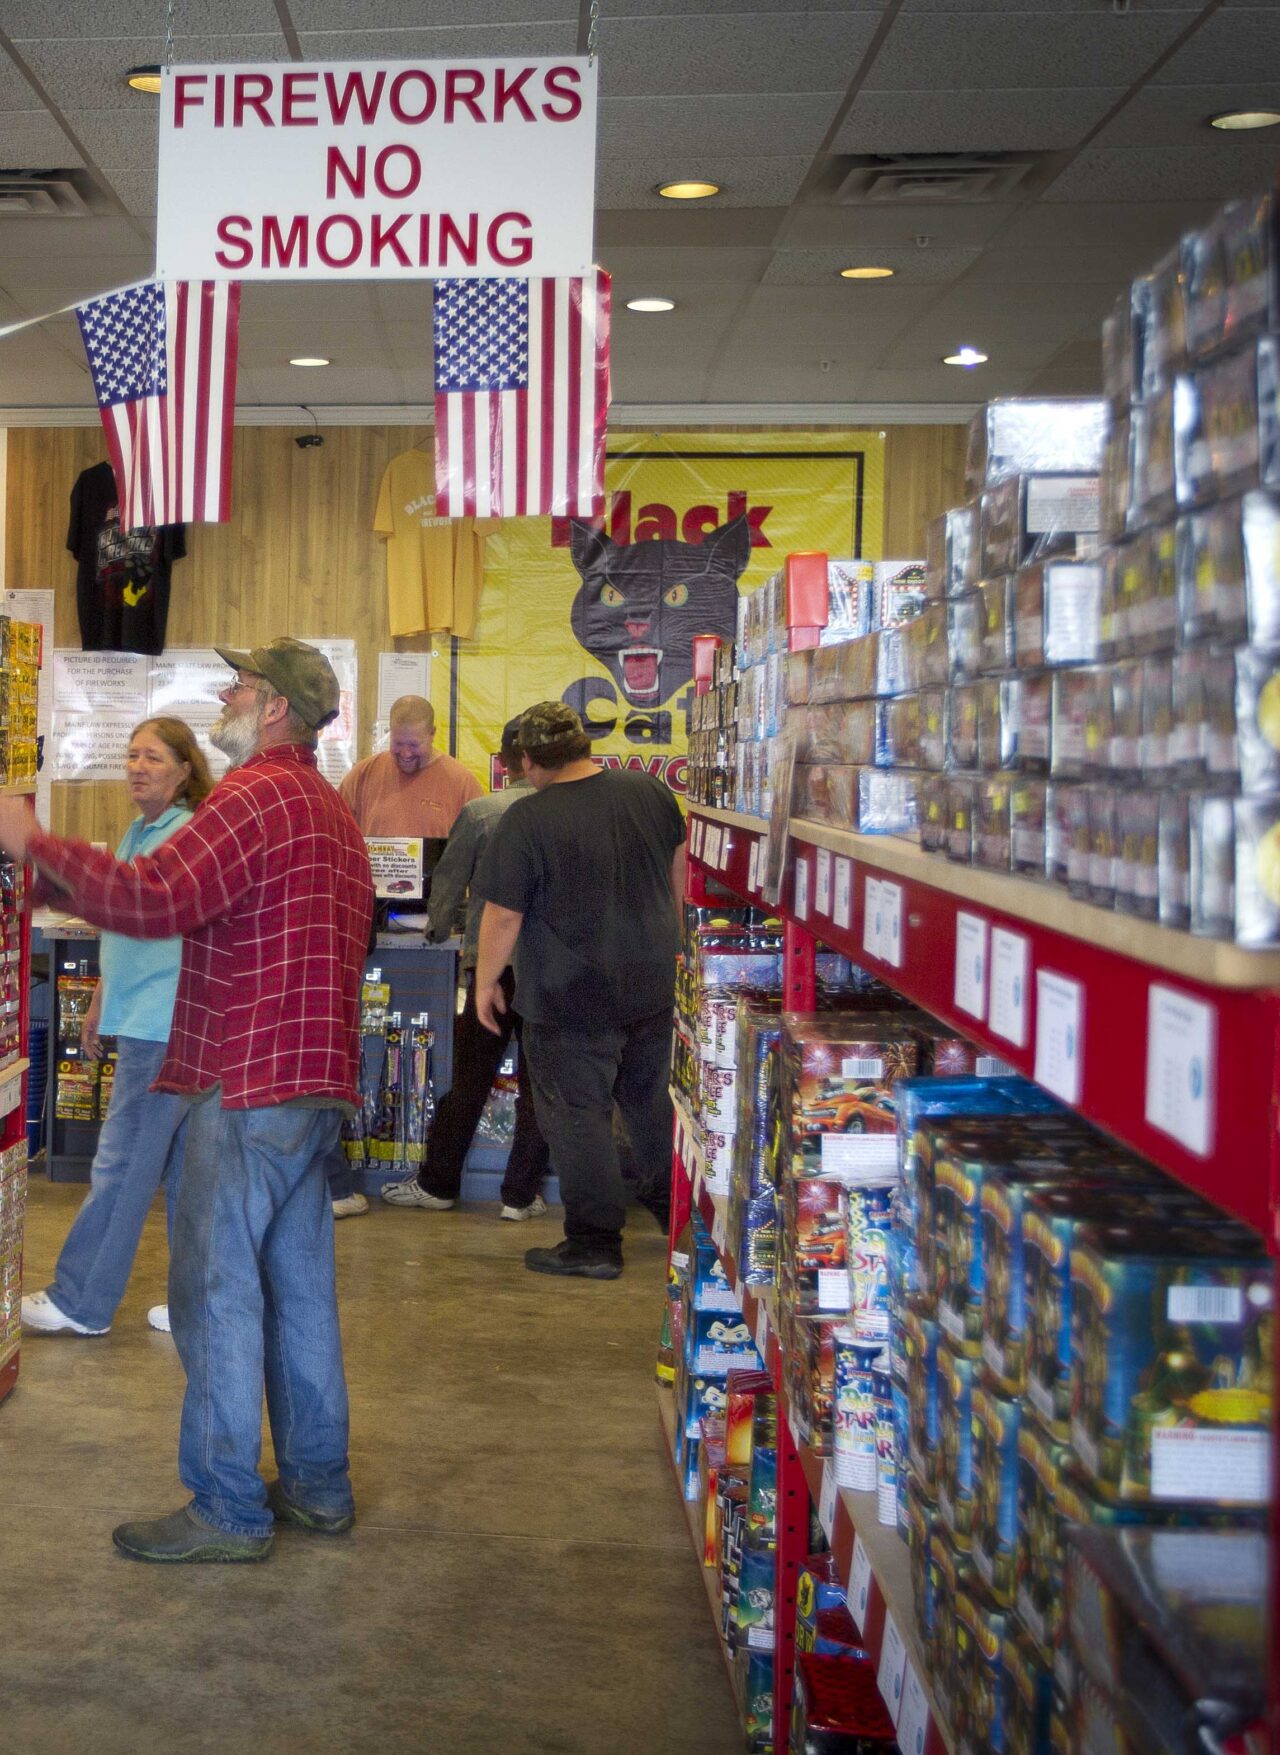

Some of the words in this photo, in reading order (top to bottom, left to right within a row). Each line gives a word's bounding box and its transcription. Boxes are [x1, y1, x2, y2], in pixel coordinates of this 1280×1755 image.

[173, 66, 582, 128] FIREWORKS
[326, 144, 421, 200] NO
[214, 211, 533, 269] SMOKING
[404, 495, 435, 515] BLAC
[63, 656, 92, 664] PICTURE
[102, 656, 138, 664] REQUIRED
[97, 668, 133, 676] PURCHASE
